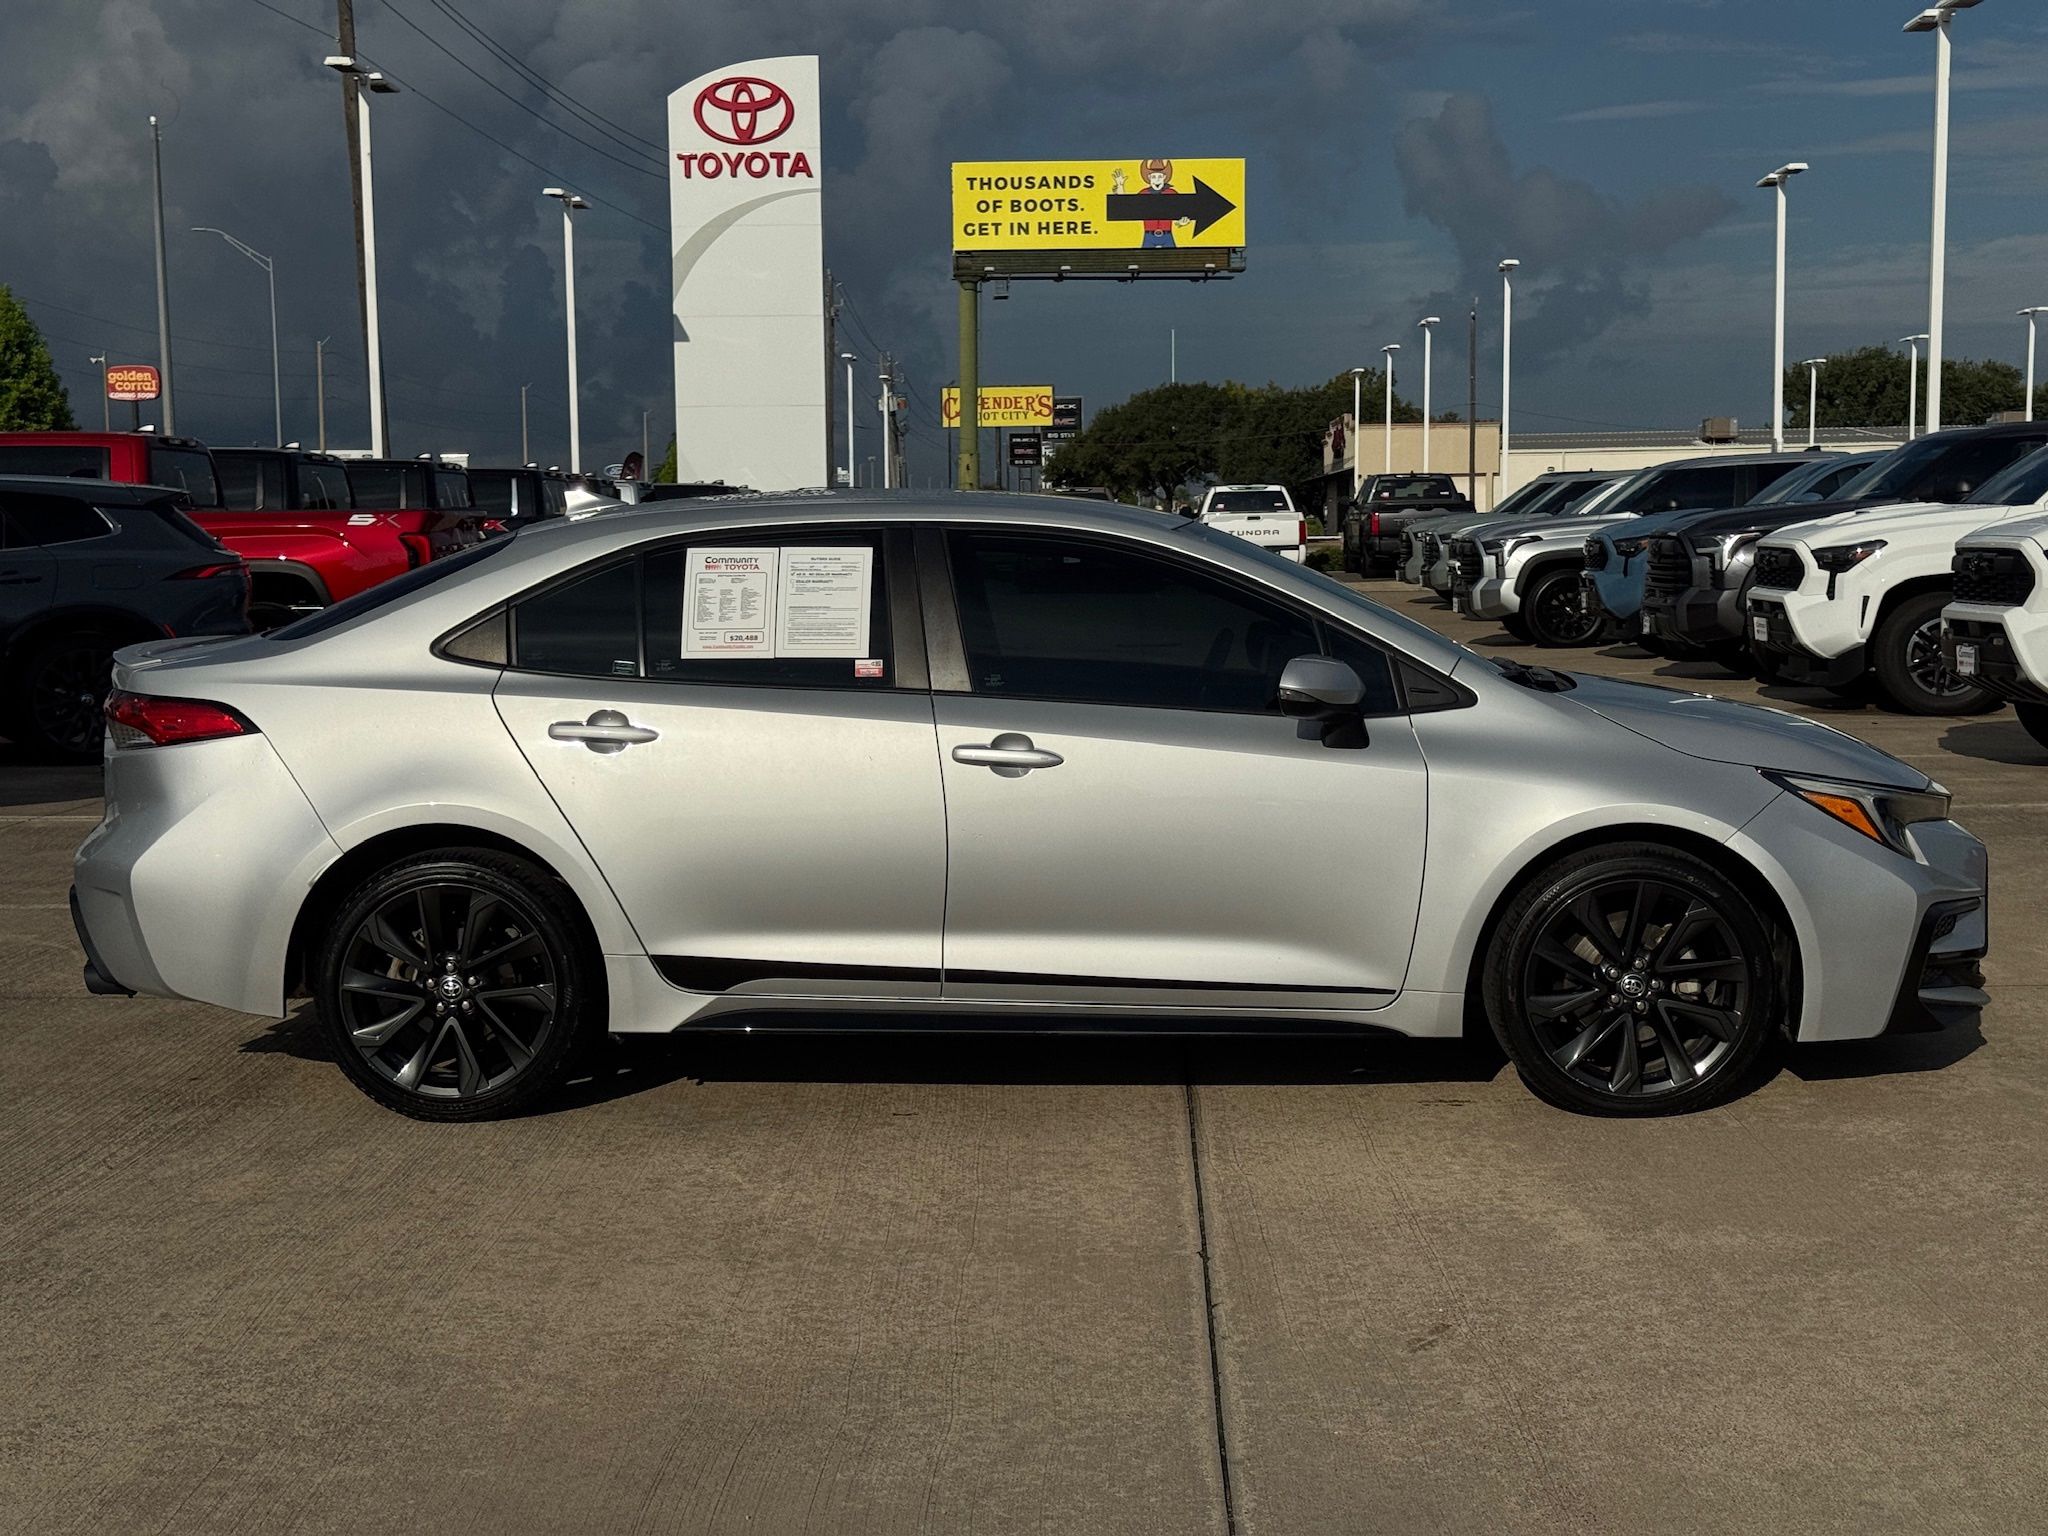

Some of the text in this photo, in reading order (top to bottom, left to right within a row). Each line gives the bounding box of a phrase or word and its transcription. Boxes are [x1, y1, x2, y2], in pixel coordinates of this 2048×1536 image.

[677, 152, 813, 179] TOYOTA
[966, 175, 1095, 190] THOUSANDS
[976, 199, 1085, 213] OF BOOTS.
[963, 221, 1098, 236] GET IN HERE.
[107, 370, 152, 383] golden
[115, 380, 156, 391] corral
[944, 394, 1053, 420] CENDER'S
[1002, 411, 1029, 420] CITY
